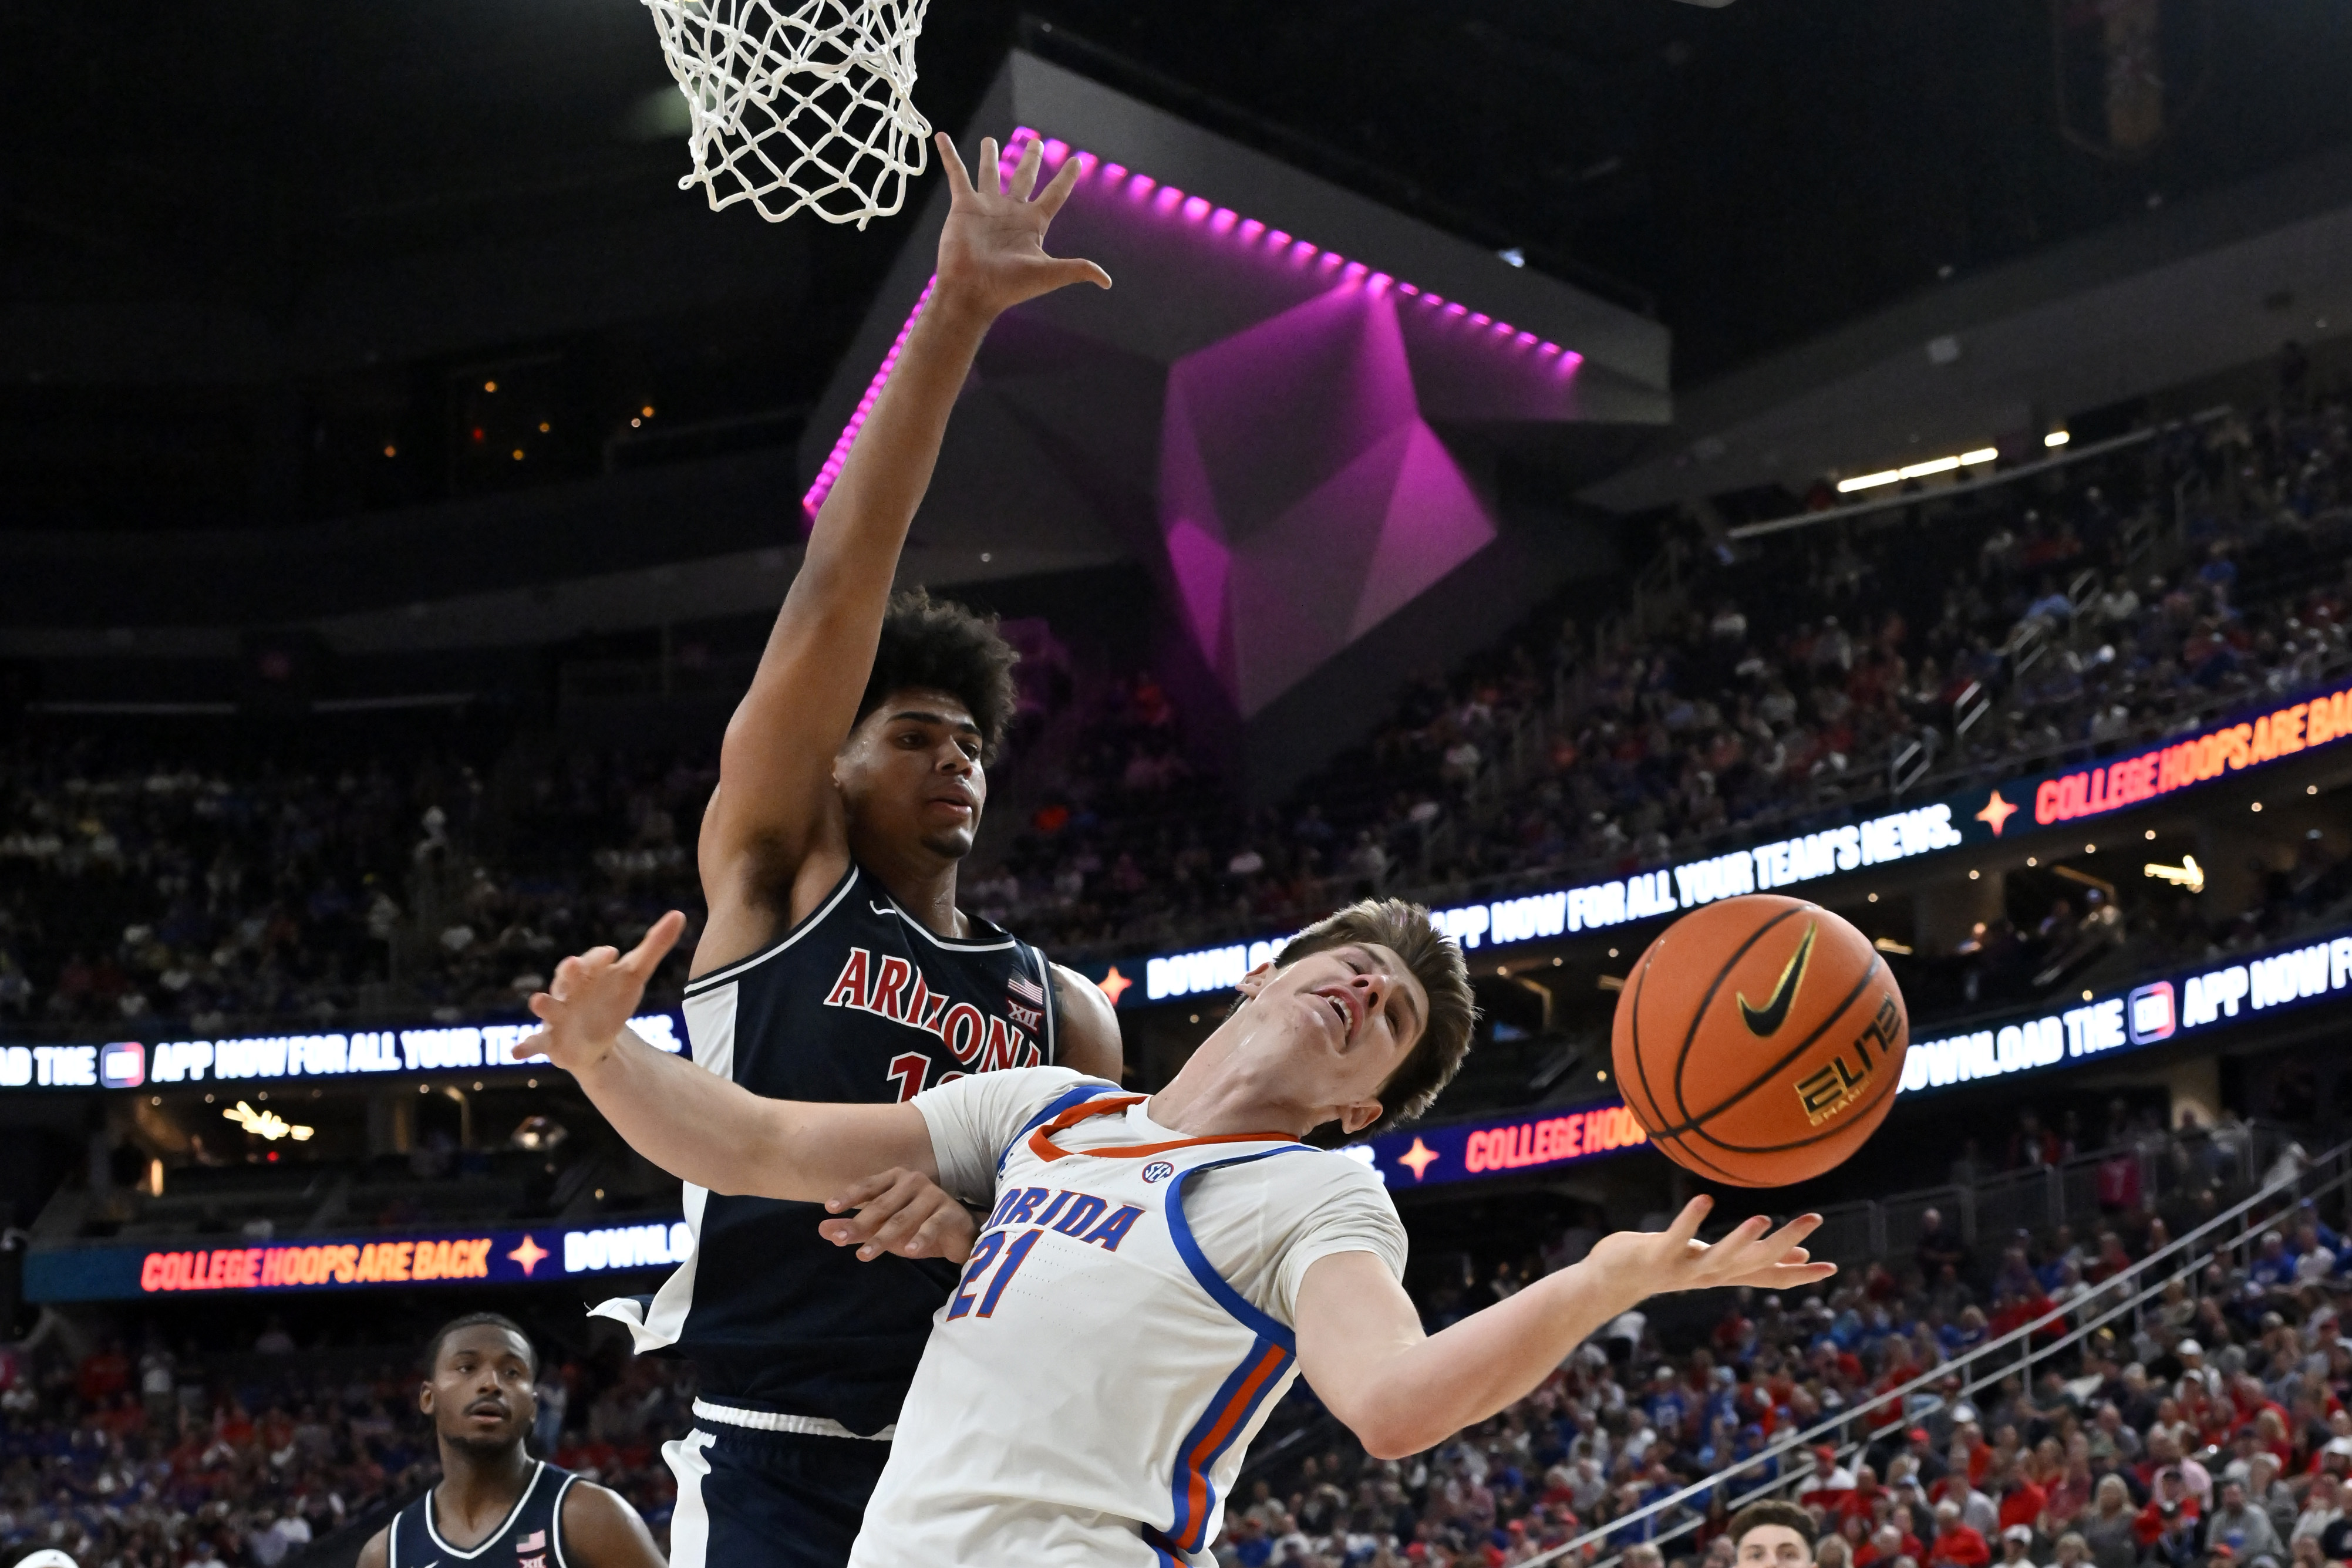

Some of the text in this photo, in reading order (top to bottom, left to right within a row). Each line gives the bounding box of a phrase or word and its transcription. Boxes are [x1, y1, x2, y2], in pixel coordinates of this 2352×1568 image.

[2035, 751, 2159, 825] COLLEGE
[2157, 723, 2253, 793] HOOPS
[2249, 703, 2309, 765] ARE
[1147, 938, 1292, 1000] DOWNLO
[1491, 891, 1566, 944] NOW
[1566, 881, 1626, 932] FOR
[1626, 869, 1677, 920] ALL
[1674, 851, 1754, 908] YOUR
[1752, 825, 1861, 890] TEAM'S
[1859, 803, 1962, 866] NEWS.
[2182, 965, 2249, 1028] APP
[2249, 942, 2330, 1010] NOW
[1007, 1000, 1042, 1031] XII
[32, 1045, 97, 1086] THE
[150, 1040, 214, 1083] APP
[214, 1037, 288, 1079] NOW
[287, 1034, 348, 1075] FOR
[347, 1031, 402, 1073] ALL
[400, 1027, 481, 1070] YOUR
[481, 1023, 551, 1066] TE
[1797, 992, 1902, 1114] ELITE
[1896, 1016, 2064, 1094] OWNLOAD
[2063, 998, 2126, 1057] THE
[887, 1051, 969, 1104] 1
[1145, 1162, 1171, 1182] SEC
[1465, 1114, 1584, 1174] COLLEGE
[564, 1222, 696, 1273] DOWNLO
[985, 1187, 1145, 1252] ORIDA
[141, 1238, 492, 1292] COLLEGE HOOPS ARE BACK
[946, 1228, 1044, 1322] 21
